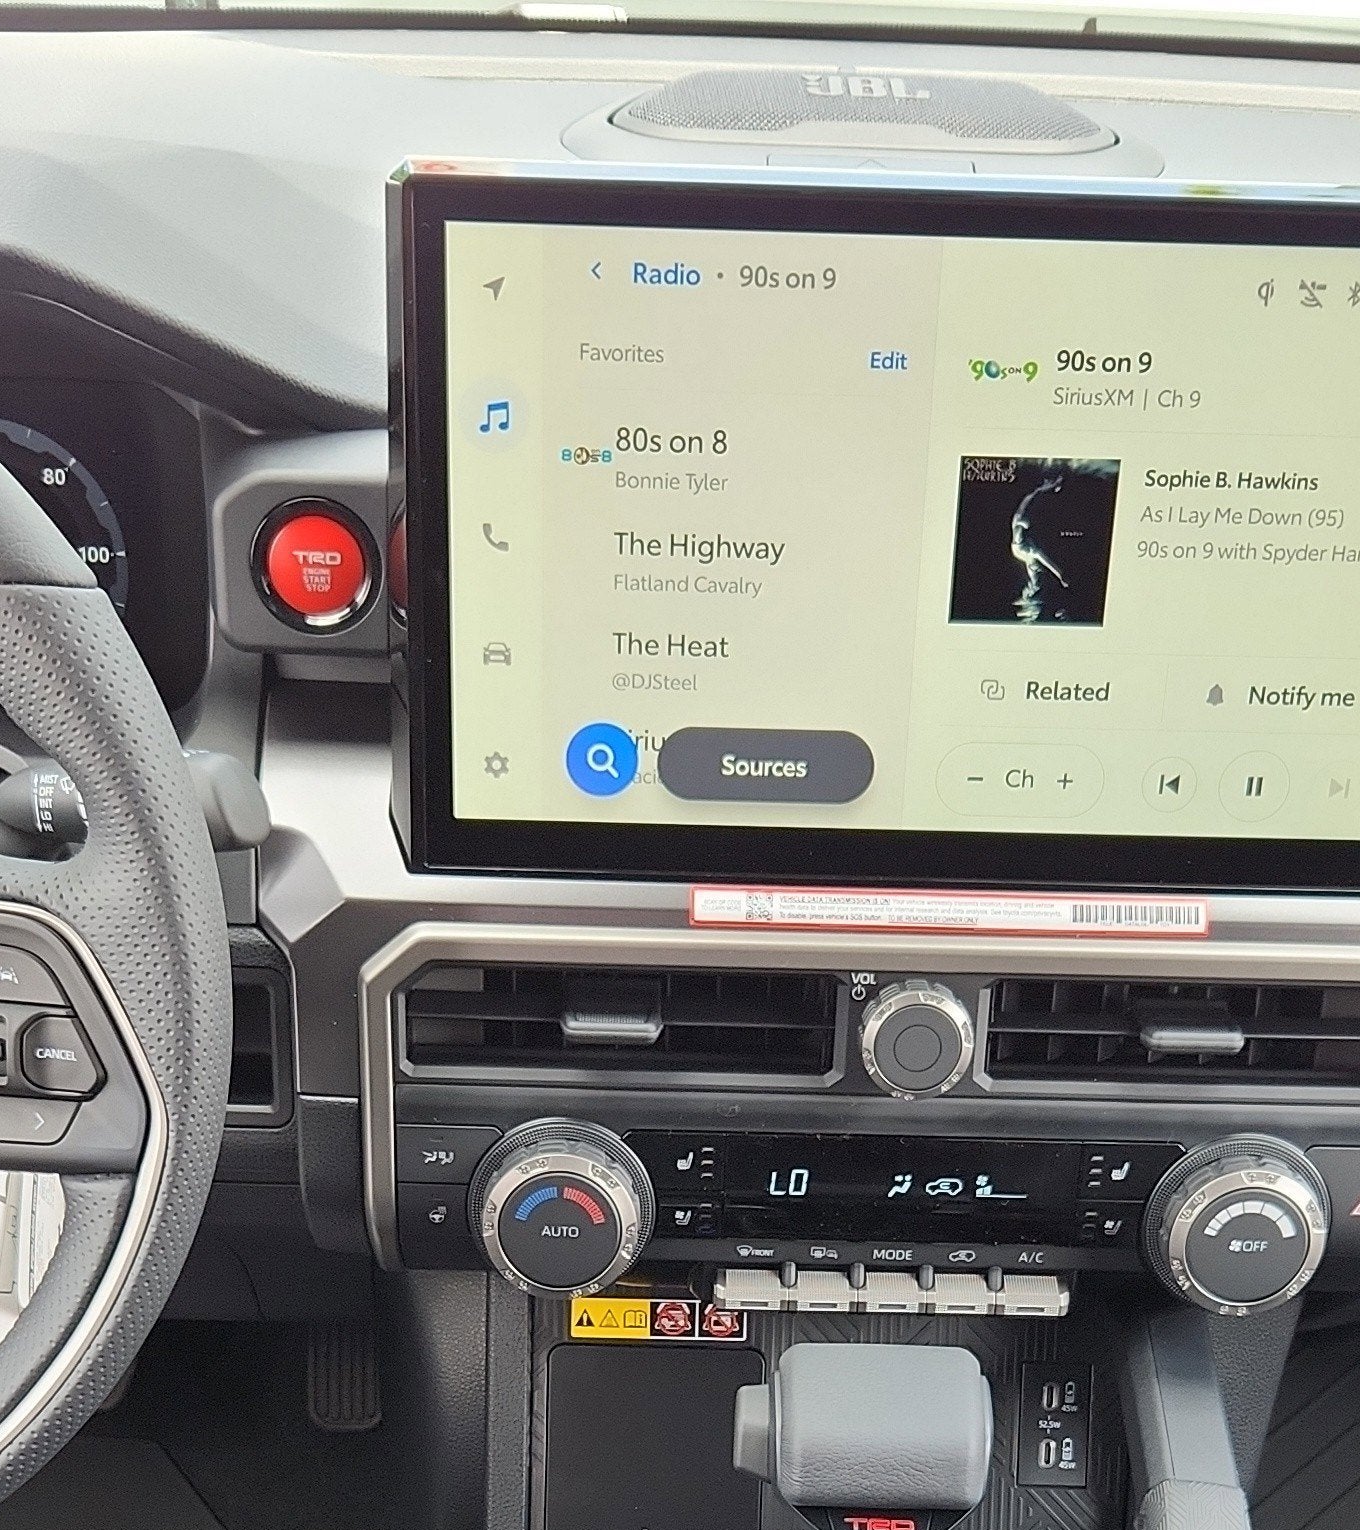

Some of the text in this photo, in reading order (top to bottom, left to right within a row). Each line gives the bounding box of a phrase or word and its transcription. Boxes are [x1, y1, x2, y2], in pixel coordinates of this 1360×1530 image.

[801, 73, 931, 101] JBL
[632, 262, 837, 290] Radio 90s on 9
[579, 342, 665, 364] Favorites
[870, 351, 908, 371] Edit
[1057, 350, 1152, 373] 90s on 9
[1053, 387, 1134, 407] SiriusXM
[1158, 389, 1183, 407] Ch
[1190, 390, 1201, 408] 9
[616, 428, 728, 455] 80s on 8
[42, 468, 66, 485] 80
[615, 471, 729, 495] Bonnie Tyler
[1145, 470, 1319, 491] Sophie B. Hawkins
[1140, 506, 1344, 529] As I Lay Me Down (95)
[79, 547, 110, 563] 100
[292, 551, 342, 566] TRD
[614, 531, 786, 566] The Highway
[1137, 541, 1168, 558] 90s
[1173, 546, 1196, 559] on
[1202, 542, 1214, 559] 9
[1218, 543, 1257, 560] with
[1262, 543, 1327, 565] Spyder
[613, 574, 763, 599] Flatland Cavalry
[612, 632, 729, 659] The Heat
[612, 673, 698, 692] @DJSteel
[1025, 681, 1110, 702] Related
[1248, 686, 1355, 710] Notify me
[721, 754, 807, 779] Sources
[1005, 769, 1034, 789] Ch
[39, 786, 54, 797] OFF
[39, 799, 53, 809] INT
[851, 972, 877, 985] VOL
[36, 1047, 77, 1062] CANCEL
[541, 1225, 579, 1238] AUTO
[751, 1247, 774, 1257] FRONT
[872, 1248, 913, 1261] MODE
[1242, 1240, 1268, 1252] OFF
[1018, 1250, 1044, 1265] A/C
